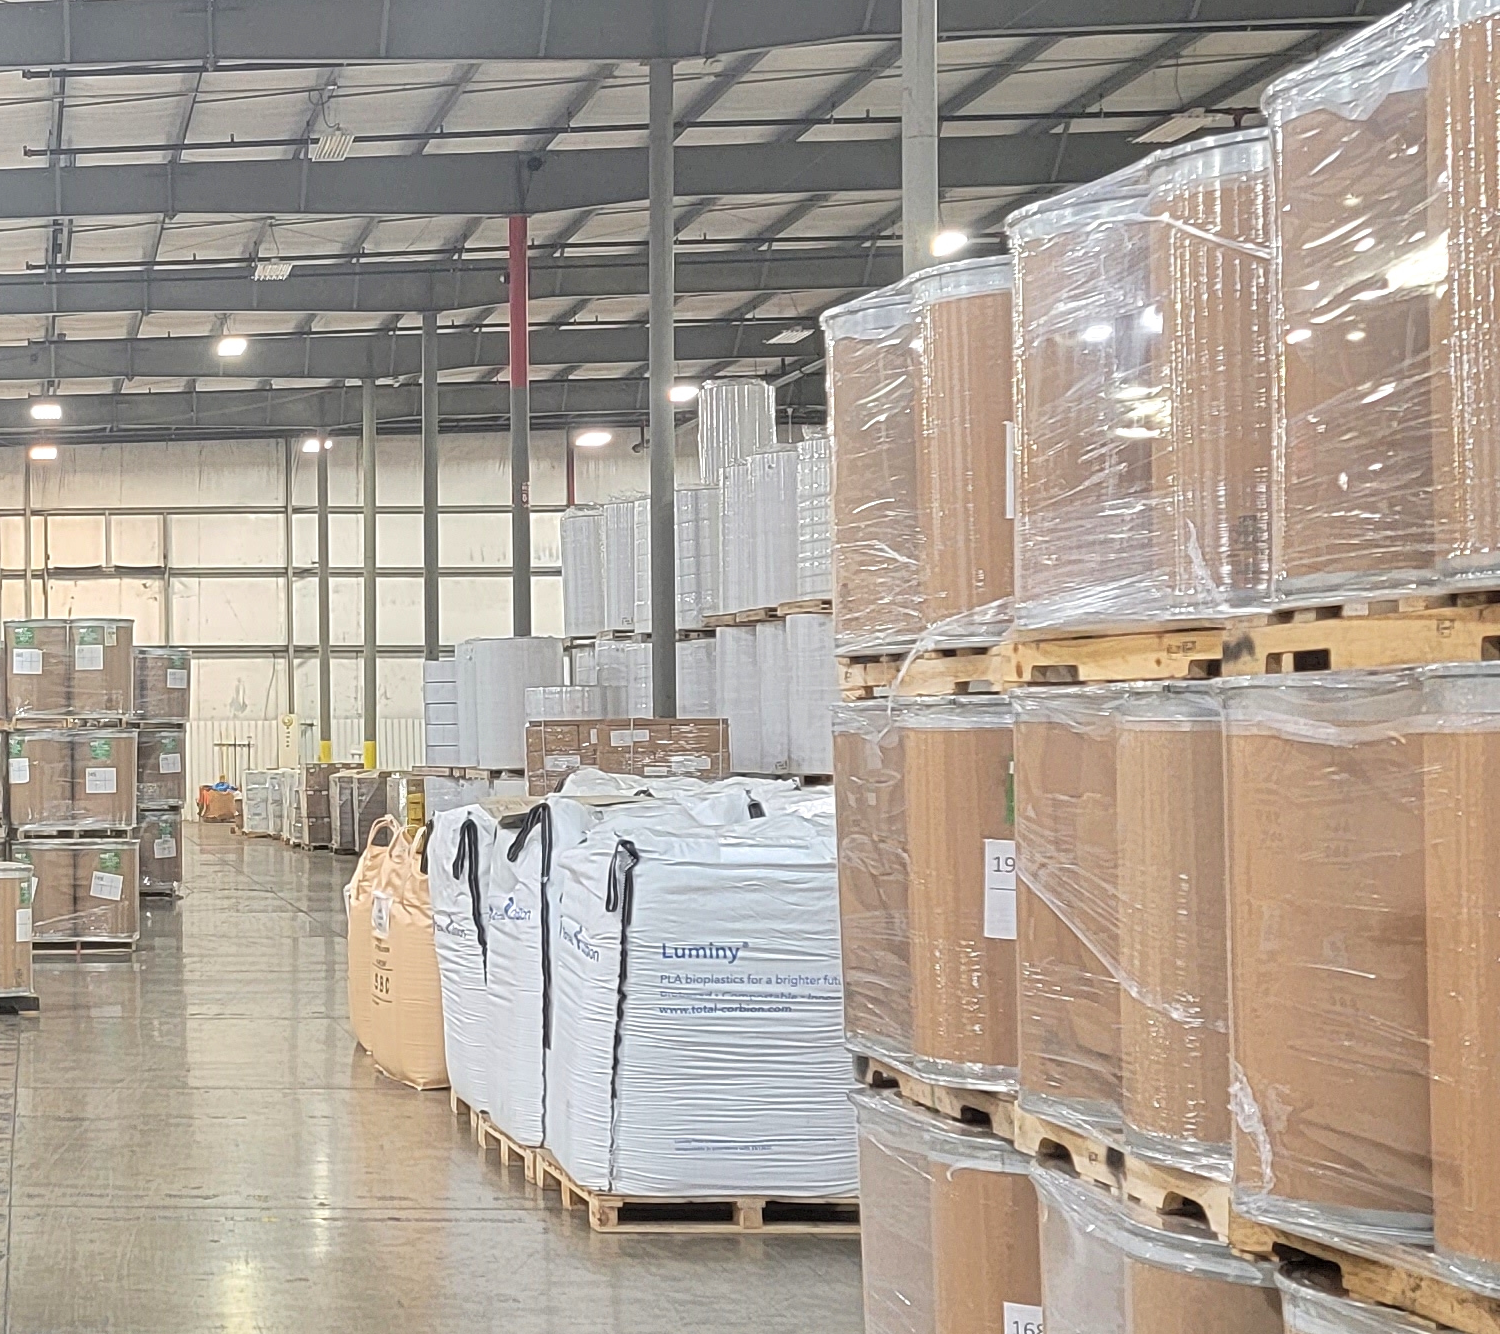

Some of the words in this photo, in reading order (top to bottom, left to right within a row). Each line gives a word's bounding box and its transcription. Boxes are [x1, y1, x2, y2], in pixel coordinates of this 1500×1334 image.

[660, 974, 682, 984] PLA
[685, 973, 745, 987] bioplastics
[747, 973, 763, 985] for
[775, 974, 821, 987] brighter
[658, 1003, 792, 1015] www.total-corbion.com
